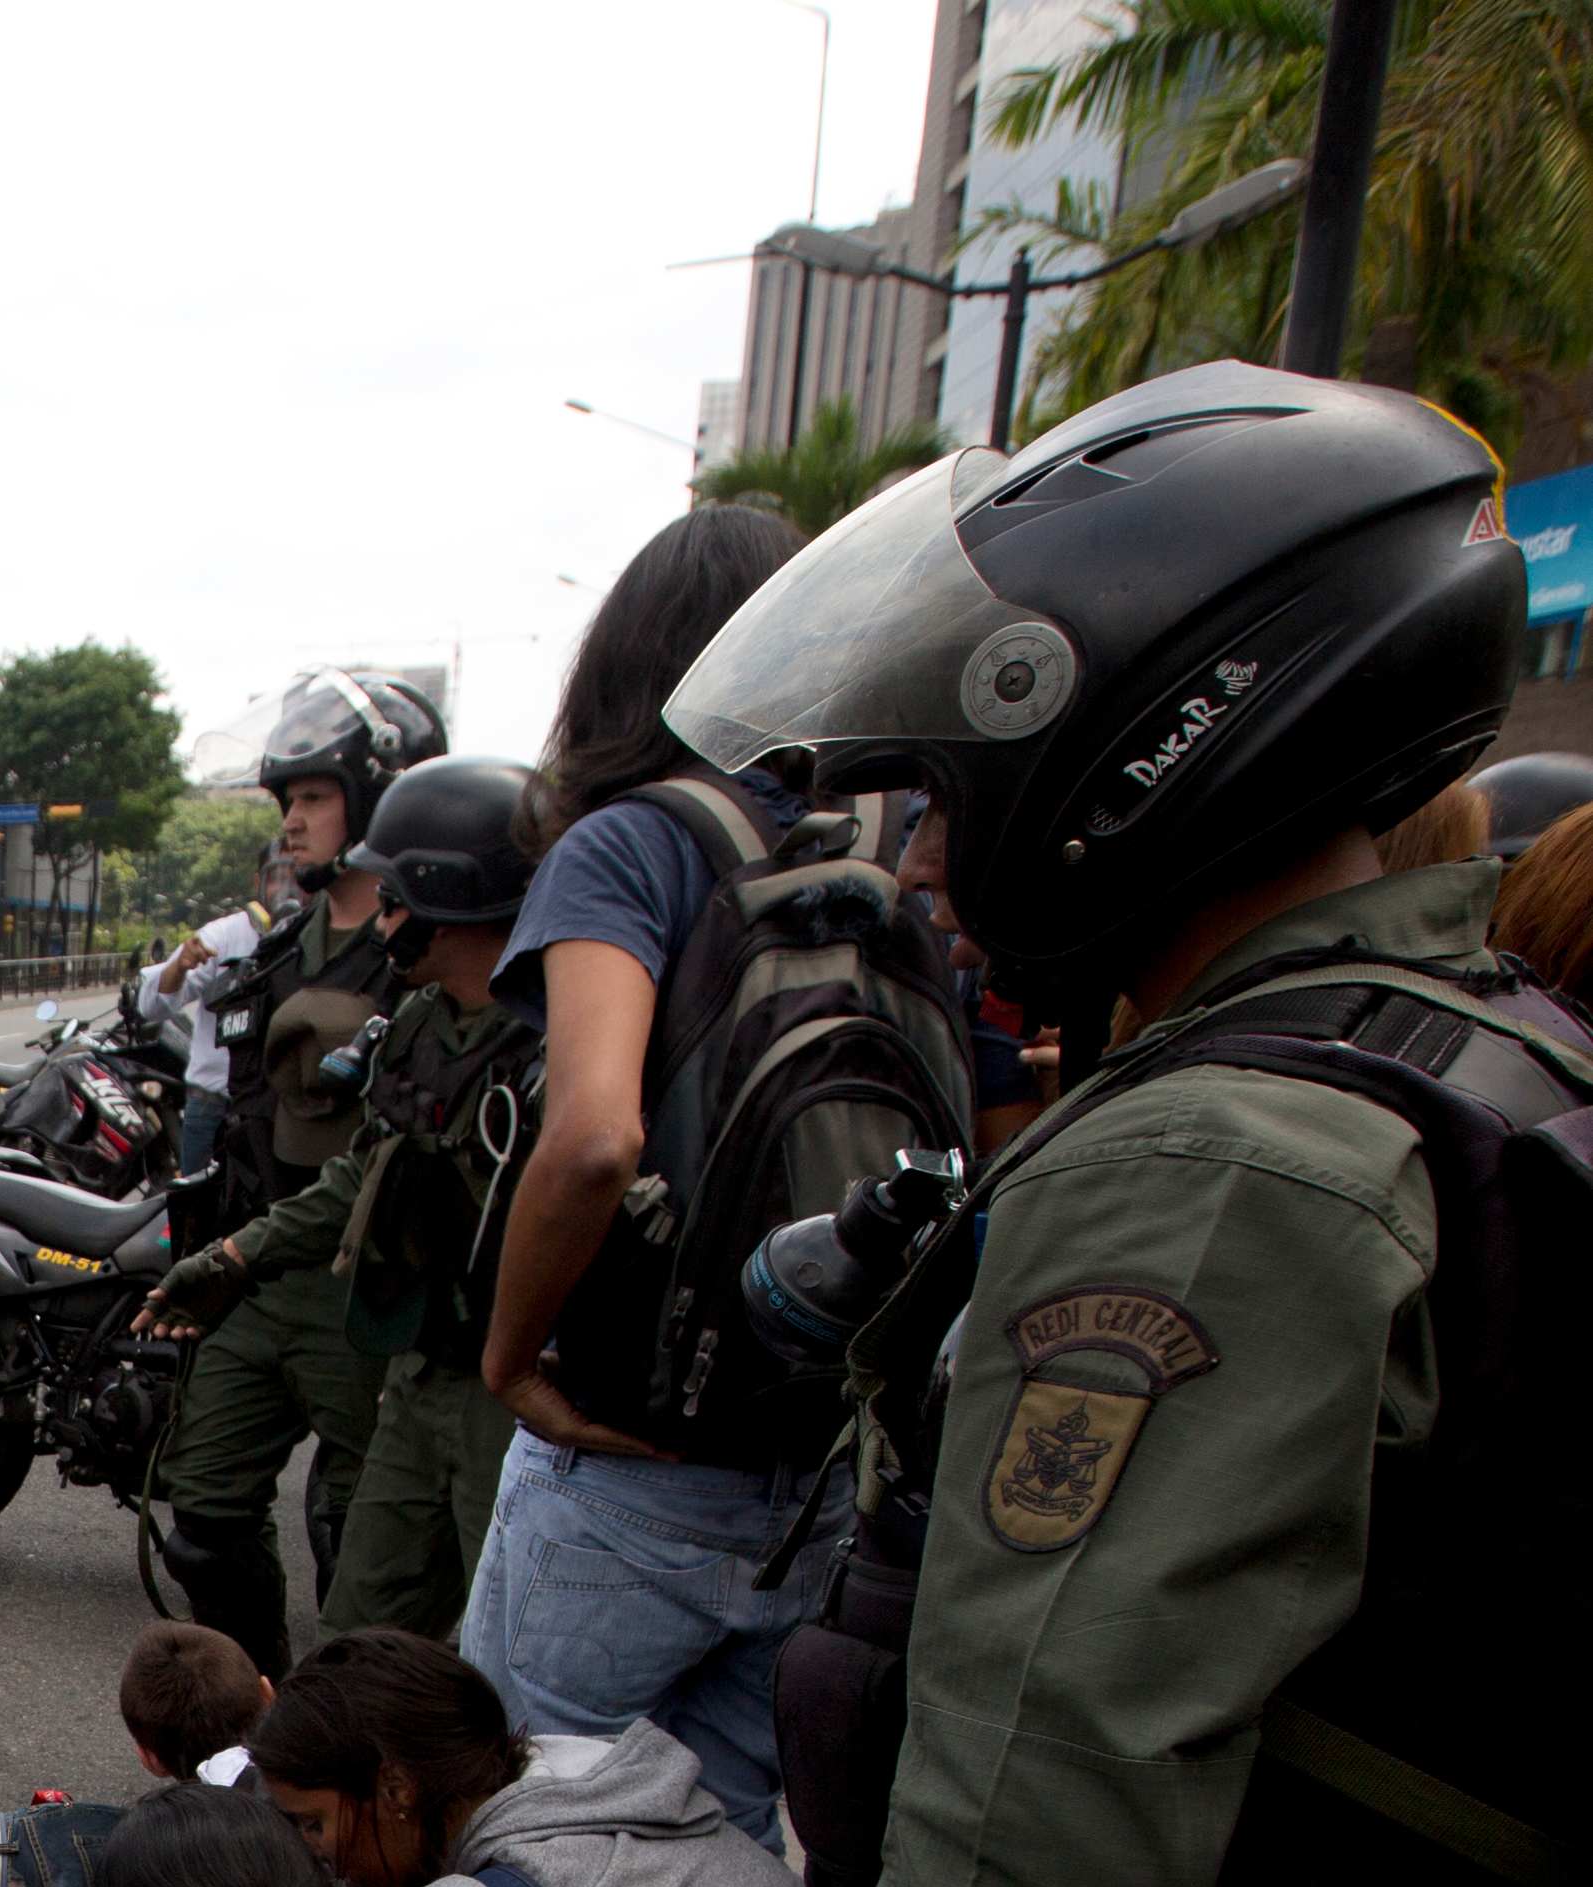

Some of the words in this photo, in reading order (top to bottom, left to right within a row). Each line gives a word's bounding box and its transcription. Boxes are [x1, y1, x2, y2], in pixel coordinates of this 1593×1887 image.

[1123, 698, 1228, 788] DAKAR
[223, 1010, 250, 1038] GNB
[36, 1247, 103, 1274] DM-51
[1025, 1302, 1081, 1348] REDI
[1095, 1300, 1200, 1369] CENTRAL
